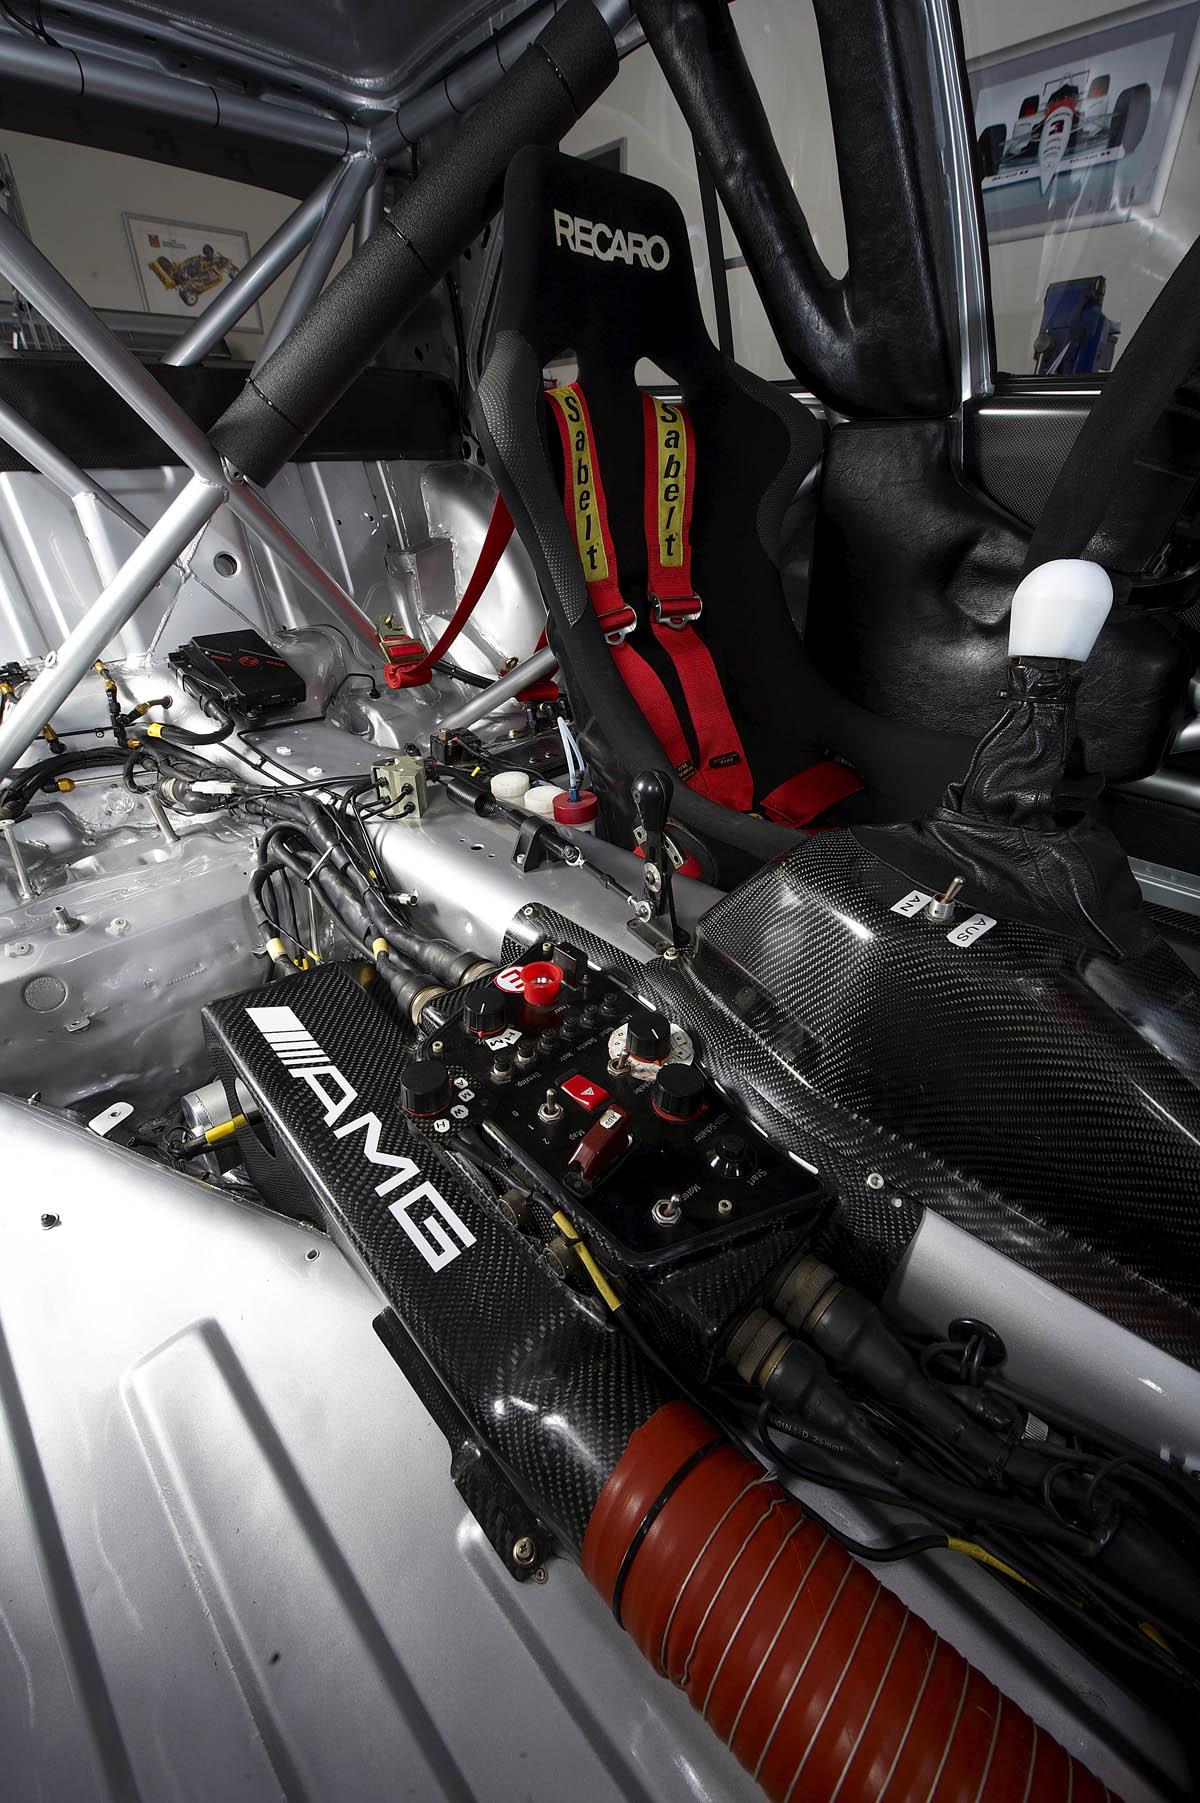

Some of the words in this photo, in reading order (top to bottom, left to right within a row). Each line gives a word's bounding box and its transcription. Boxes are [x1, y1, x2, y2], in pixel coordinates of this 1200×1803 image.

[553, 208, 670, 271] RECARO
[564, 395, 598, 570] Sabelt
[660, 402, 681, 557] Sabelt
[899, 895, 920, 912] AN
[956, 918, 987, 942] AUS
[504, 1031, 516, 1041] H
[460, 1091, 473, 1100] M
[453, 1108, 465, 1116] W
[435, 1120, 447, 1130] H
[543, 1137, 550, 1145] 2
[569, 1129, 586, 1141] Map
[287, 1064, 478, 1273] AMG
[747, 1168, 768, 1186] Start
[681, 1183, 701, 1201] Motor
